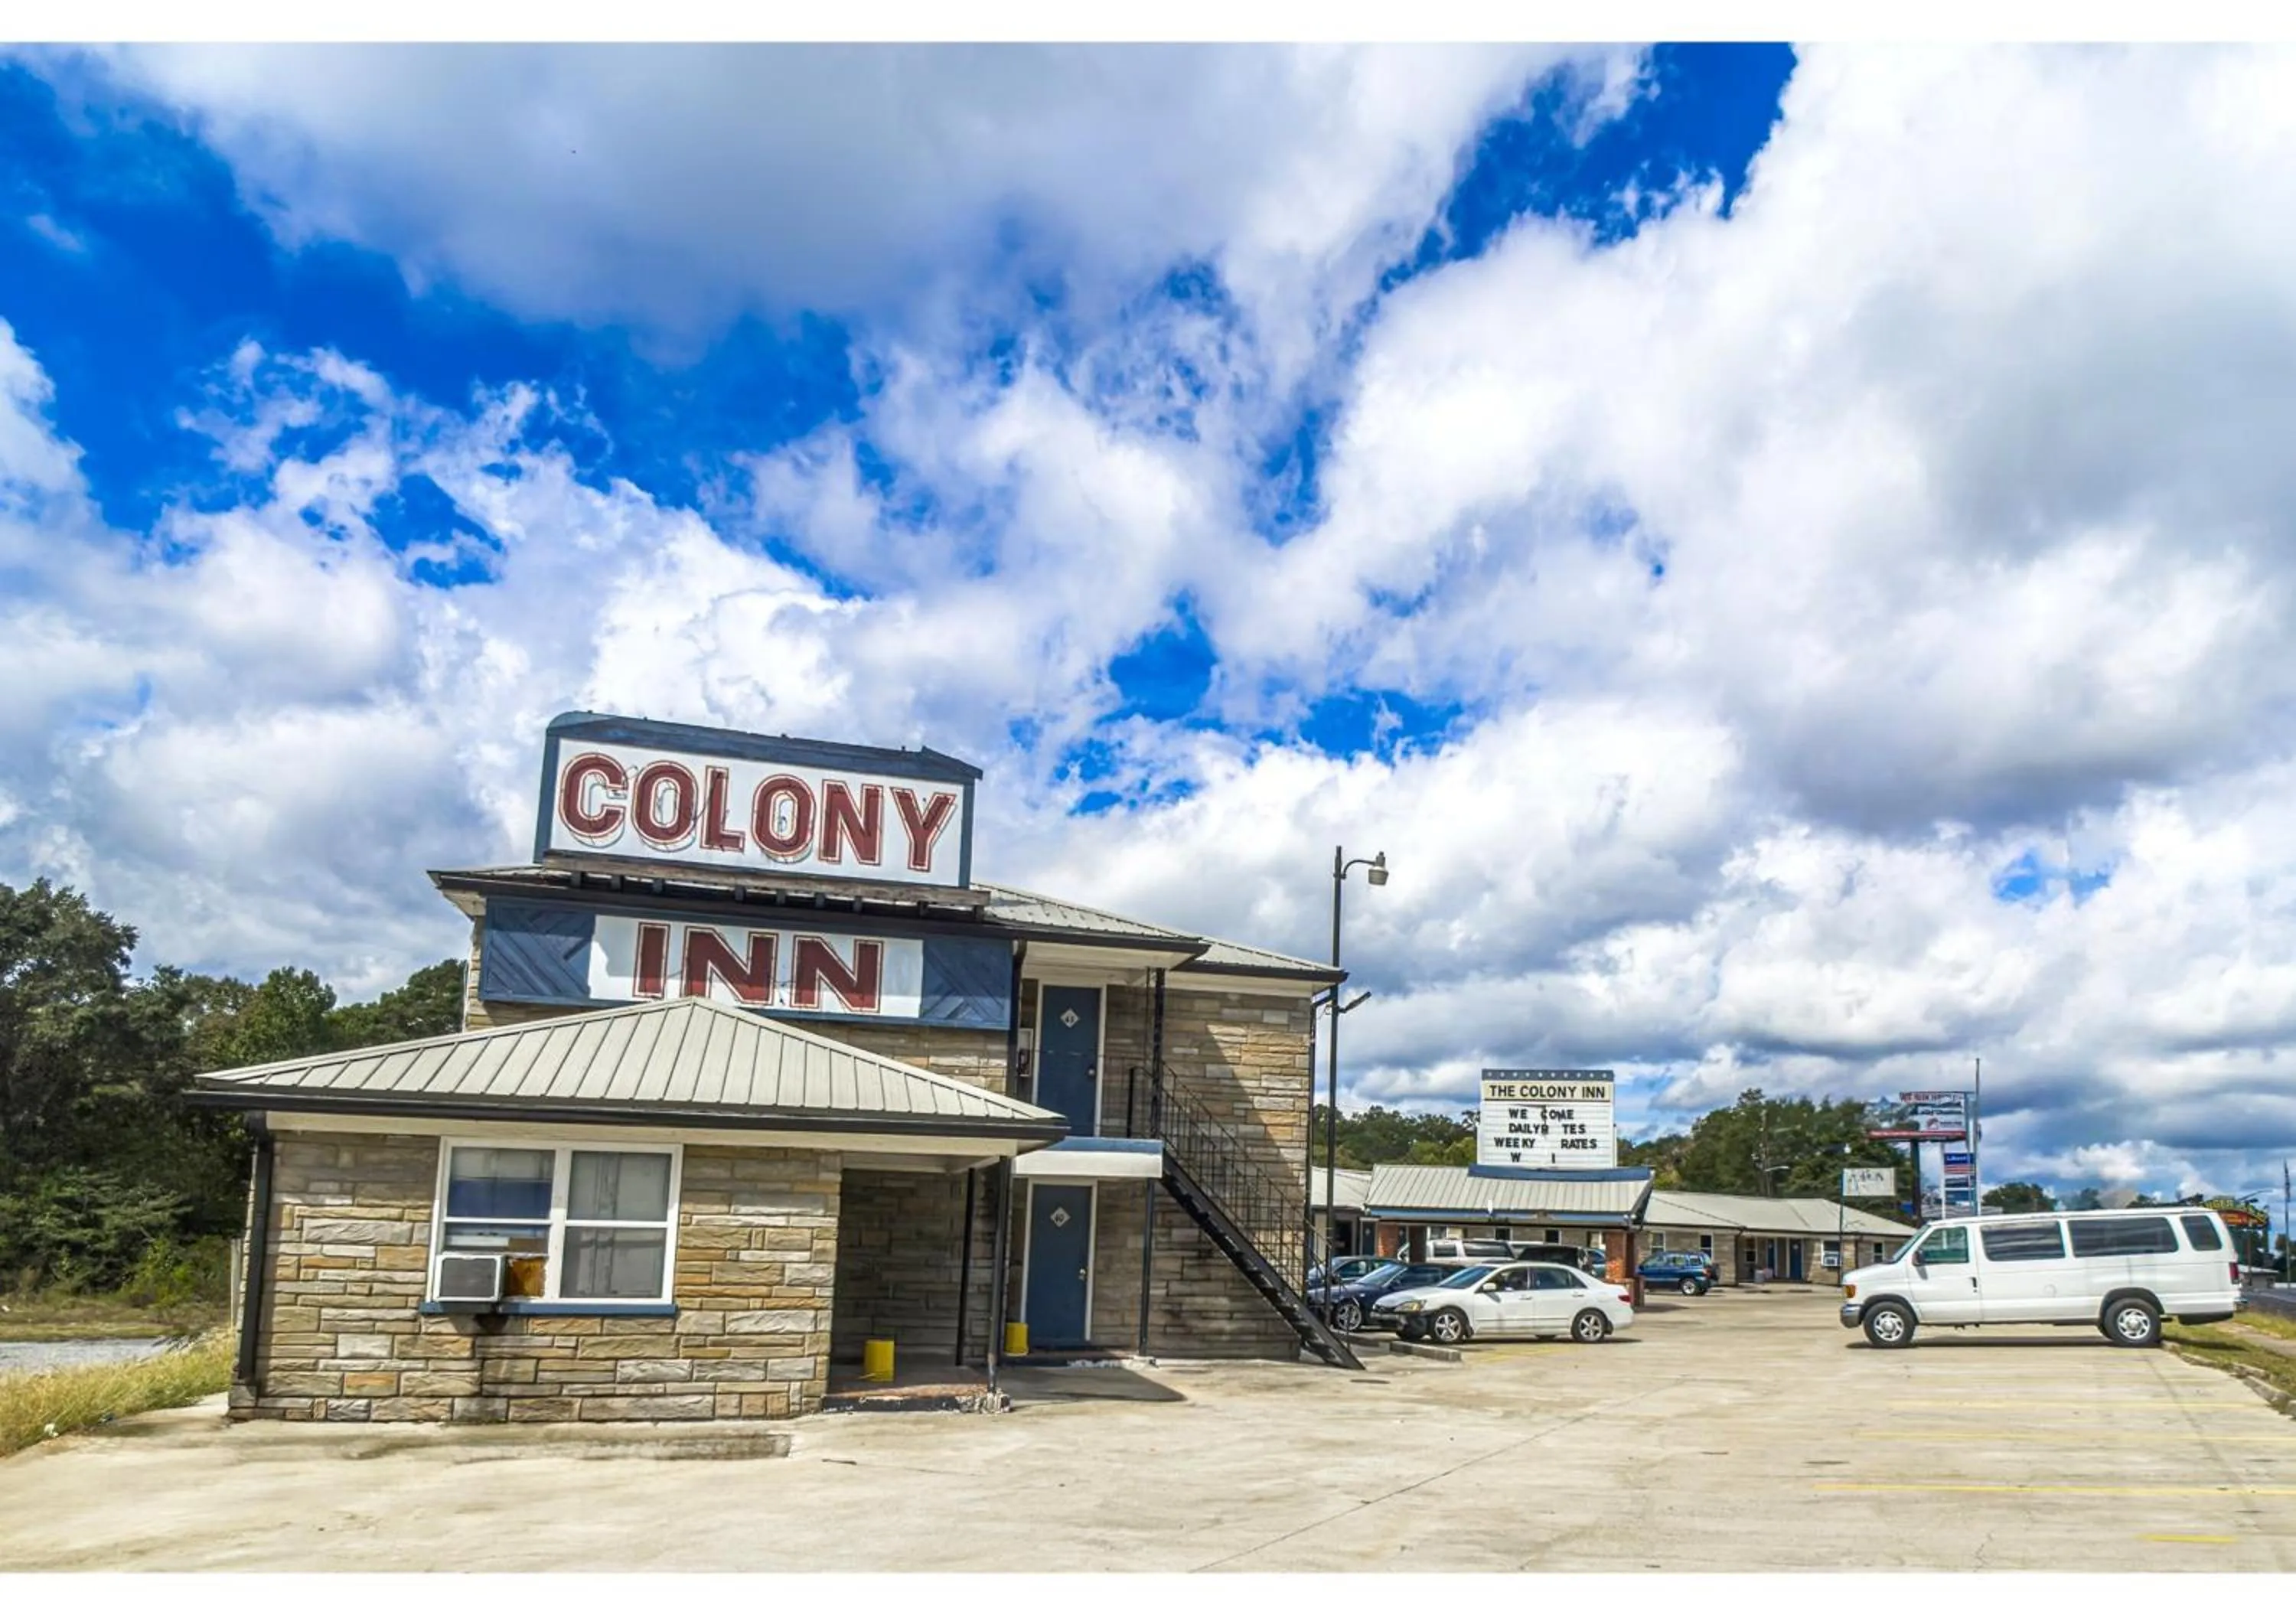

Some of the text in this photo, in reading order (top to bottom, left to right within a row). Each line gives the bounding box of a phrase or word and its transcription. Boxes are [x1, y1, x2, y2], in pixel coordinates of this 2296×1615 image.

[559, 752, 957, 872] COLONY
[633, 921, 884, 1013] INN
[1489, 1085, 1605, 1098] THE COLONY INN
[1561, 1138, 1597, 1149] RATES
